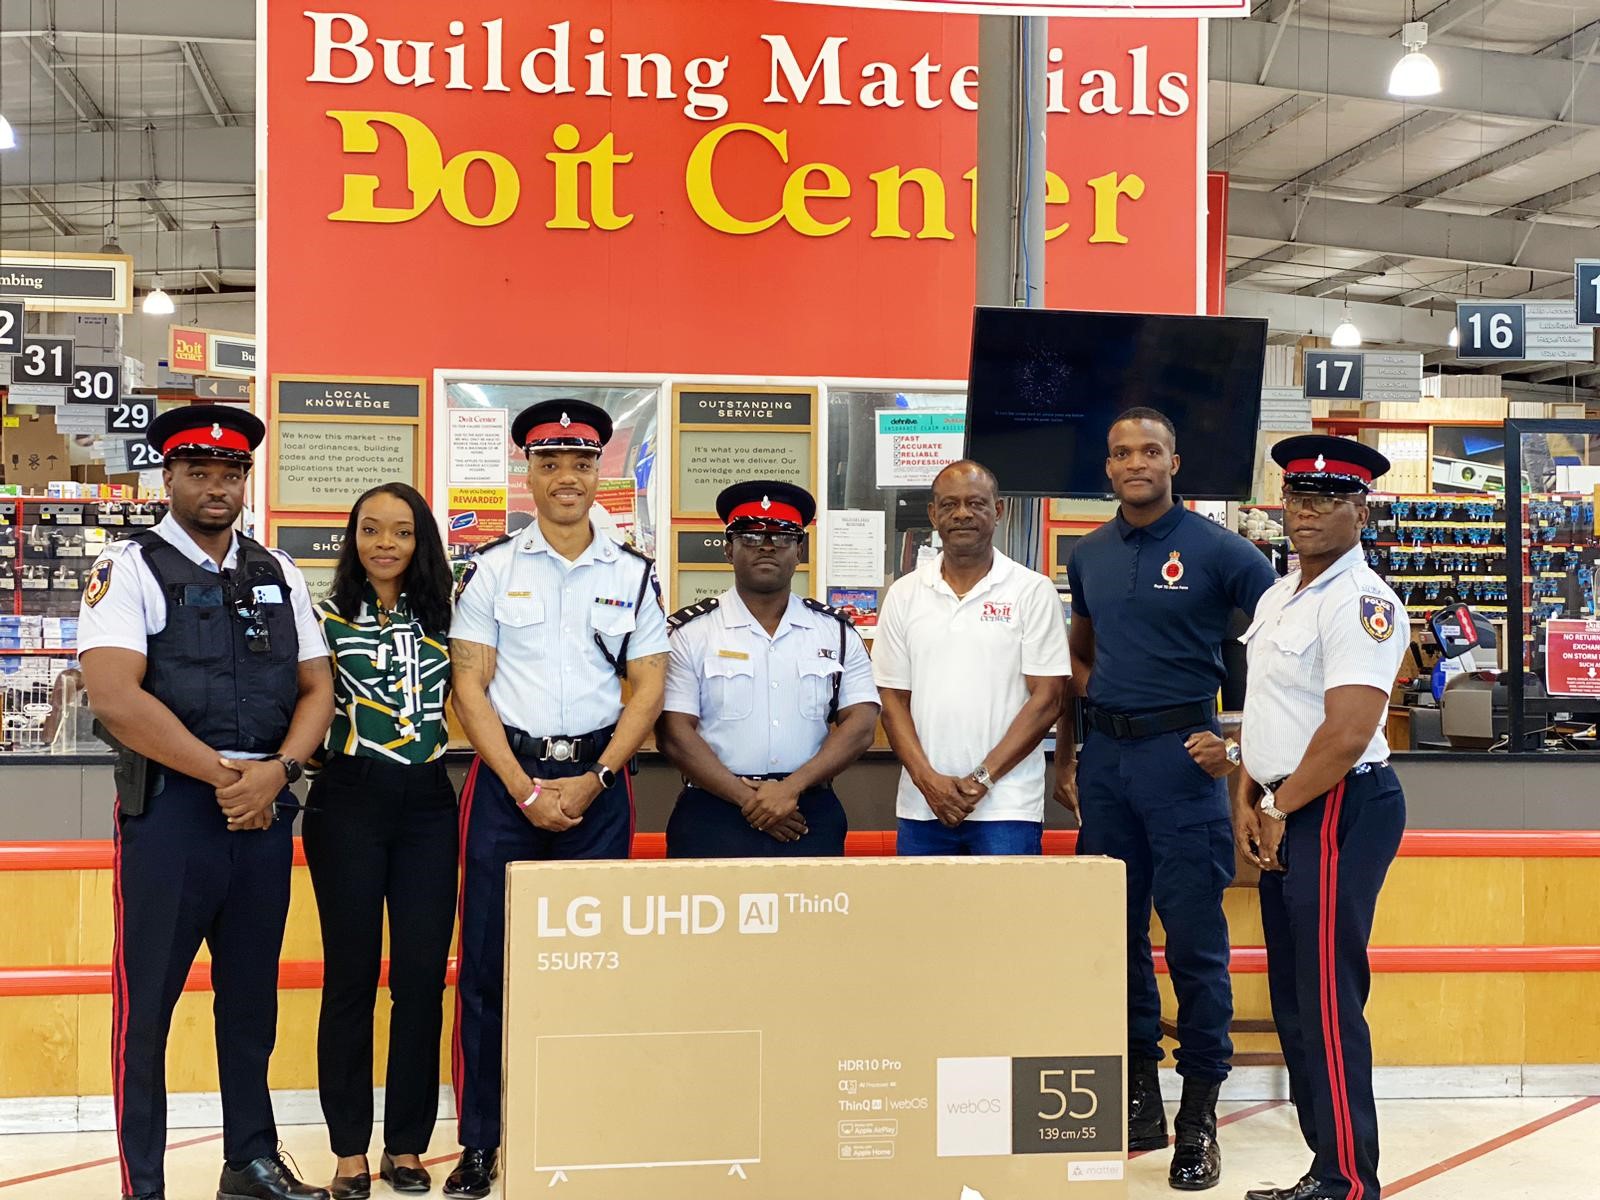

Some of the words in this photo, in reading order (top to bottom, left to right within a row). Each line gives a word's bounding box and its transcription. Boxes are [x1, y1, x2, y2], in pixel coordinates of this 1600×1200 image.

[303, 11, 729, 121] Building
[760, 34, 1190, 117] Mateials
[326, 110, 520, 227] Do
[545, 124, 635, 231] it
[686, 122, 1146, 245] Cenr
[1468, 312, 1513, 349] 16
[176, 339, 193, 353] Do
[24, 345, 62, 377] 31
[1315, 359, 1354, 391] 17
[73, 370, 114, 399] 30
[325, 390, 371, 400] LOCAL
[305, 399, 391, 409] KNOWLEDGE
[699, 400, 793, 410] OUTSTANDING
[112, 403, 149, 429] 29
[718, 410, 774, 418] SERVICE
[309, 443, 361, 451] ordinances,
[364, 445, 399, 453] building
[734, 447, 750, 455] you
[279, 464, 333, 472] applications
[687, 467, 733, 475] knowledge
[288, 474, 305, 482] Our
[307, 475, 342, 483] experts
[713, 477, 731, 485] help
[453, 496, 503, 504] REWARDED?
[1364, 597, 1391, 611] POLICE
[537, 896, 602, 938] LG
[622, 894, 726, 936] UHD
[743, 900, 774, 927] AI
[784, 892, 850, 915] ThinQ
[537, 951, 620, 971] 55UR73
[838, 1059, 880, 1072] HDR10
[882, 1058, 902, 1071] Pro
[1038, 1069, 1098, 1120] 55
[838, 1099, 870, 1112] ThinQ
[890, 1097, 929, 1110] webOS
[947, 1098, 1001, 1114] webOS
[854, 1127, 873, 1135] Apple
[1038, 1127, 1059, 1140] 139
[853, 1149, 872, 1157] Apple
[872, 1148, 891, 1156] Home
